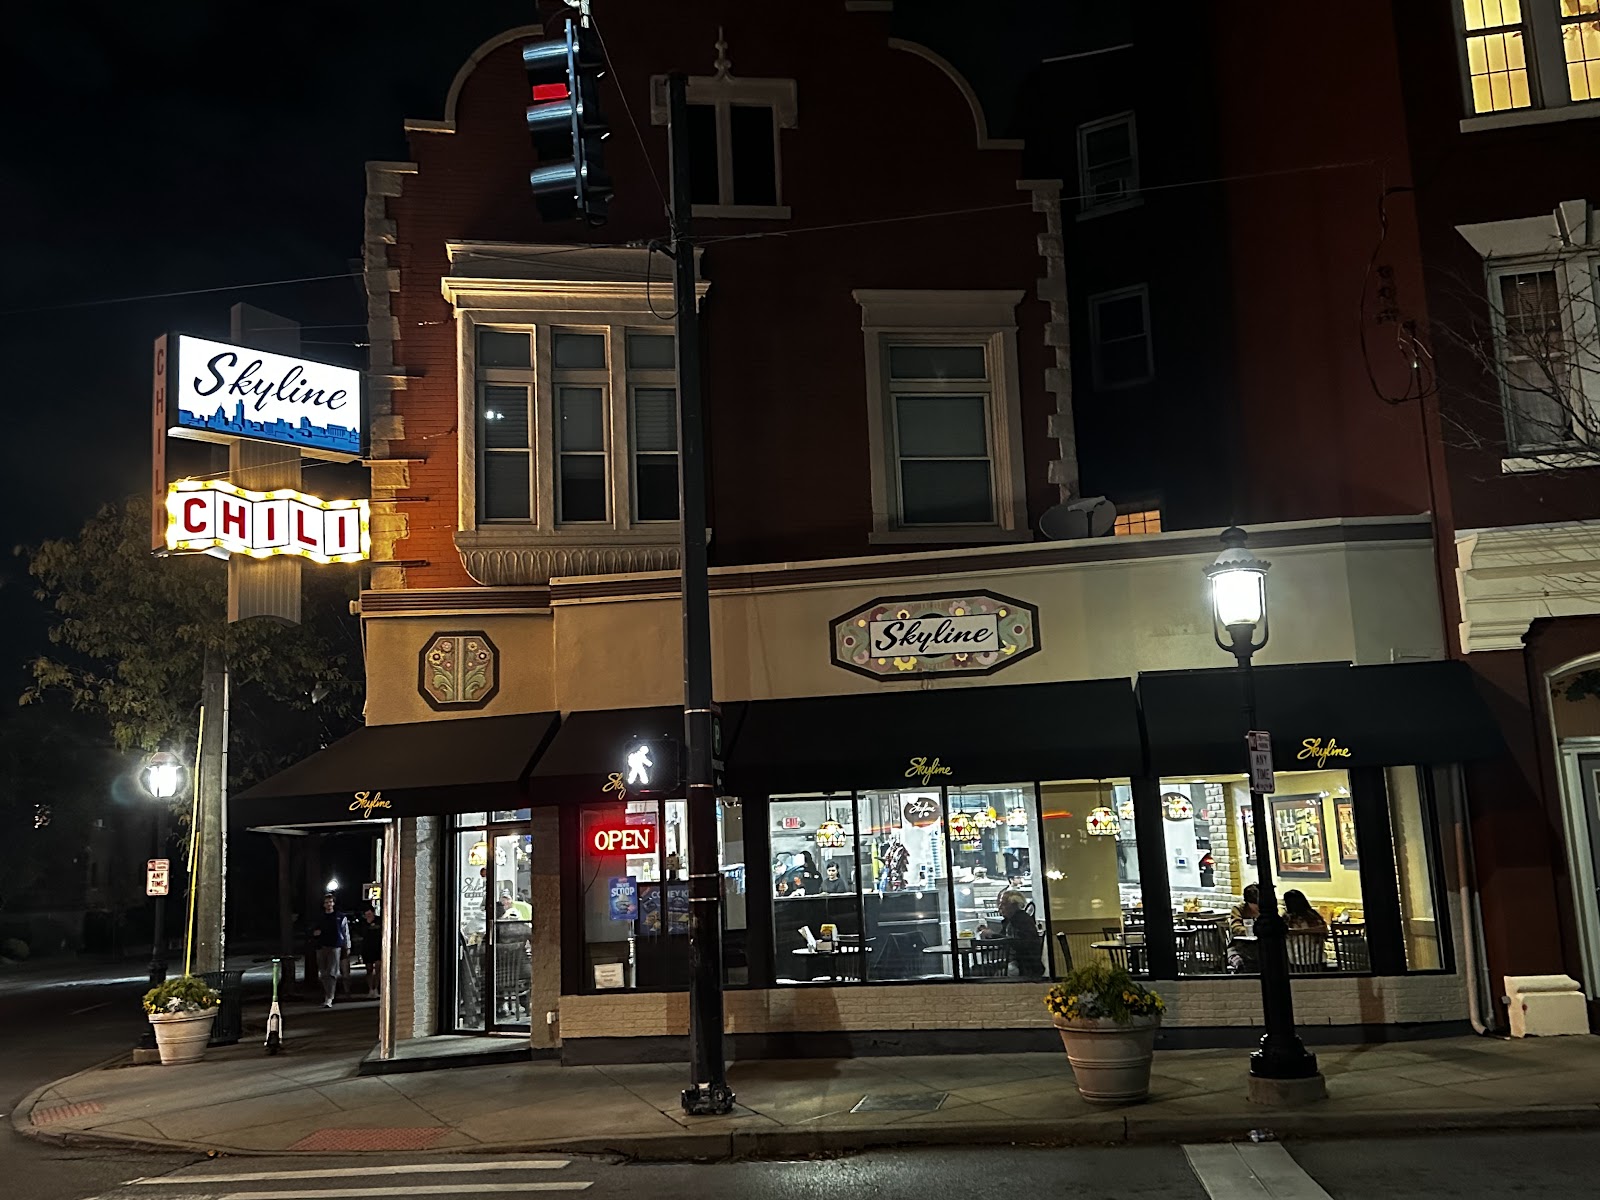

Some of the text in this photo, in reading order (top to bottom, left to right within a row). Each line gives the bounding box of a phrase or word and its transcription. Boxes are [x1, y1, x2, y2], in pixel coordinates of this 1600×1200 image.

[194, 352, 347, 411] Skyline
[183, 498, 346, 548] CHILI
[875, 619, 993, 653] Skyline
[1256, 753, 1267, 766] ANY
[1297, 737, 1351, 768] Skyline
[904, 756, 953, 785] Skyline
[1256, 768, 1271, 780] TIME
[349, 791, 392, 818] Skyline
[594, 828, 651, 851] OPEN
[611, 886, 635, 897] SCOOP
